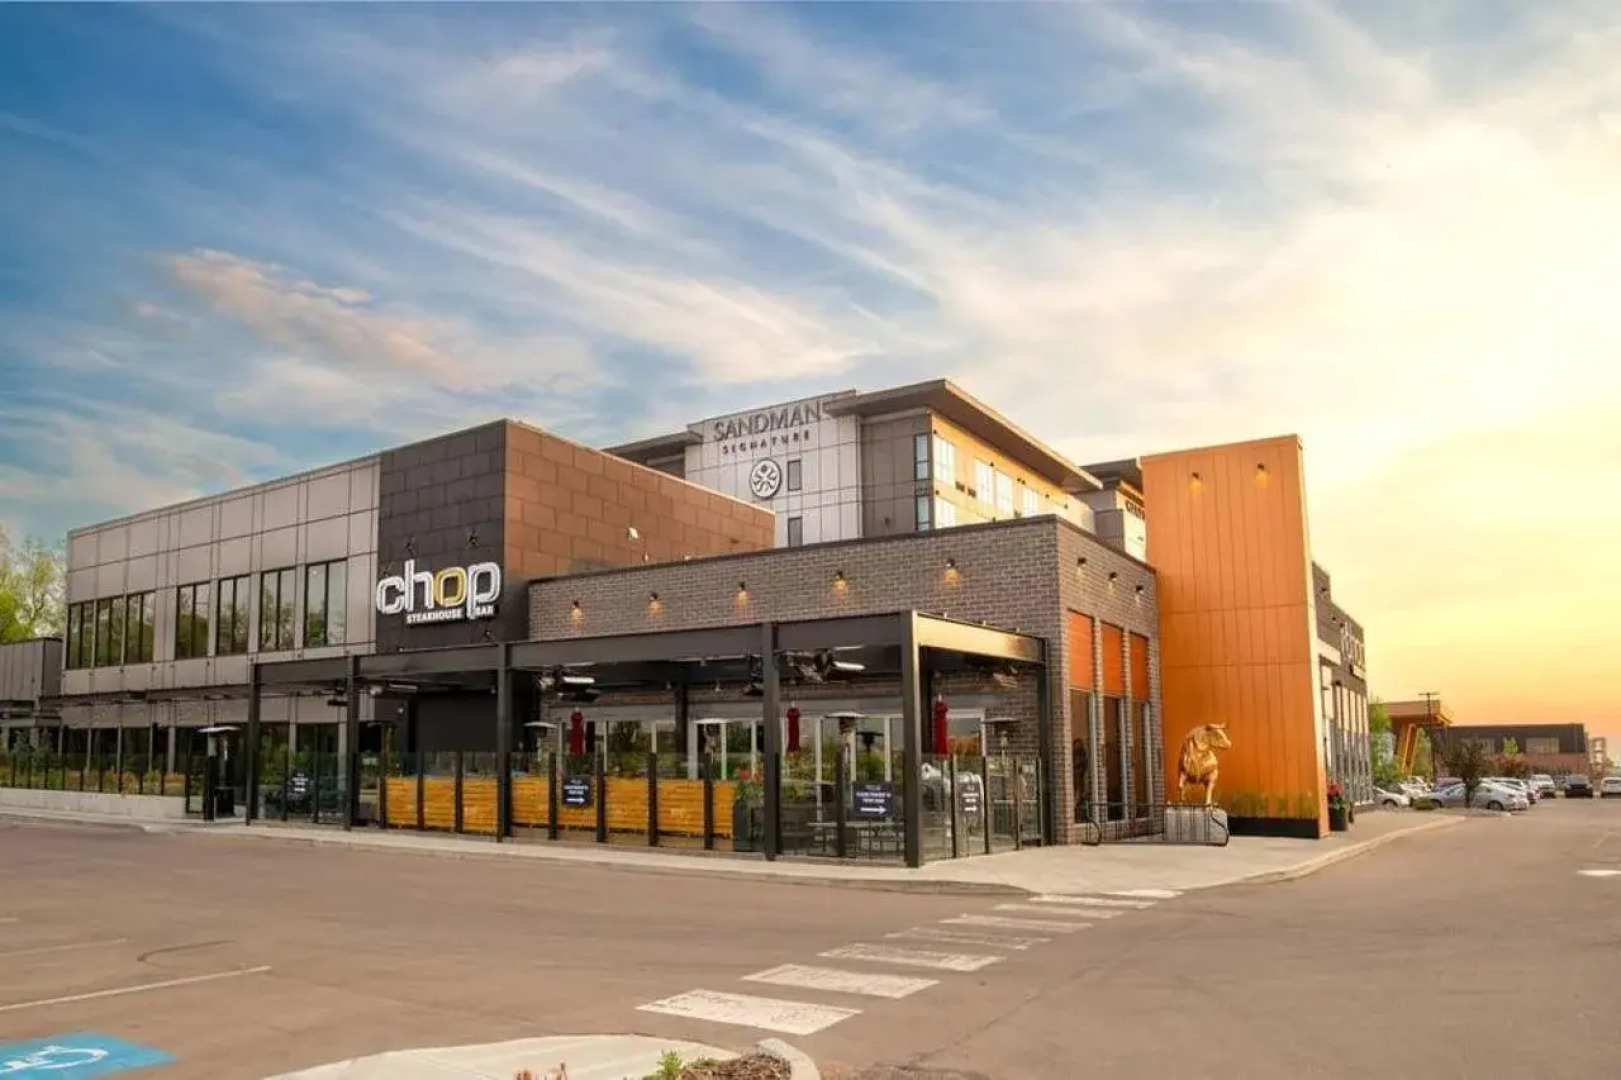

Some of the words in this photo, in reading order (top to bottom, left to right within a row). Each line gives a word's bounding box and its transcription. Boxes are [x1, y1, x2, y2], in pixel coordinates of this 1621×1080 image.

[714, 401, 820, 442] SANDMAN
[722, 429, 809, 454] SIGNATURE
[376, 559, 500, 619] chop
[406, 608, 463, 624] STEAKHOUSE
[474, 605, 494, 616] BAR
